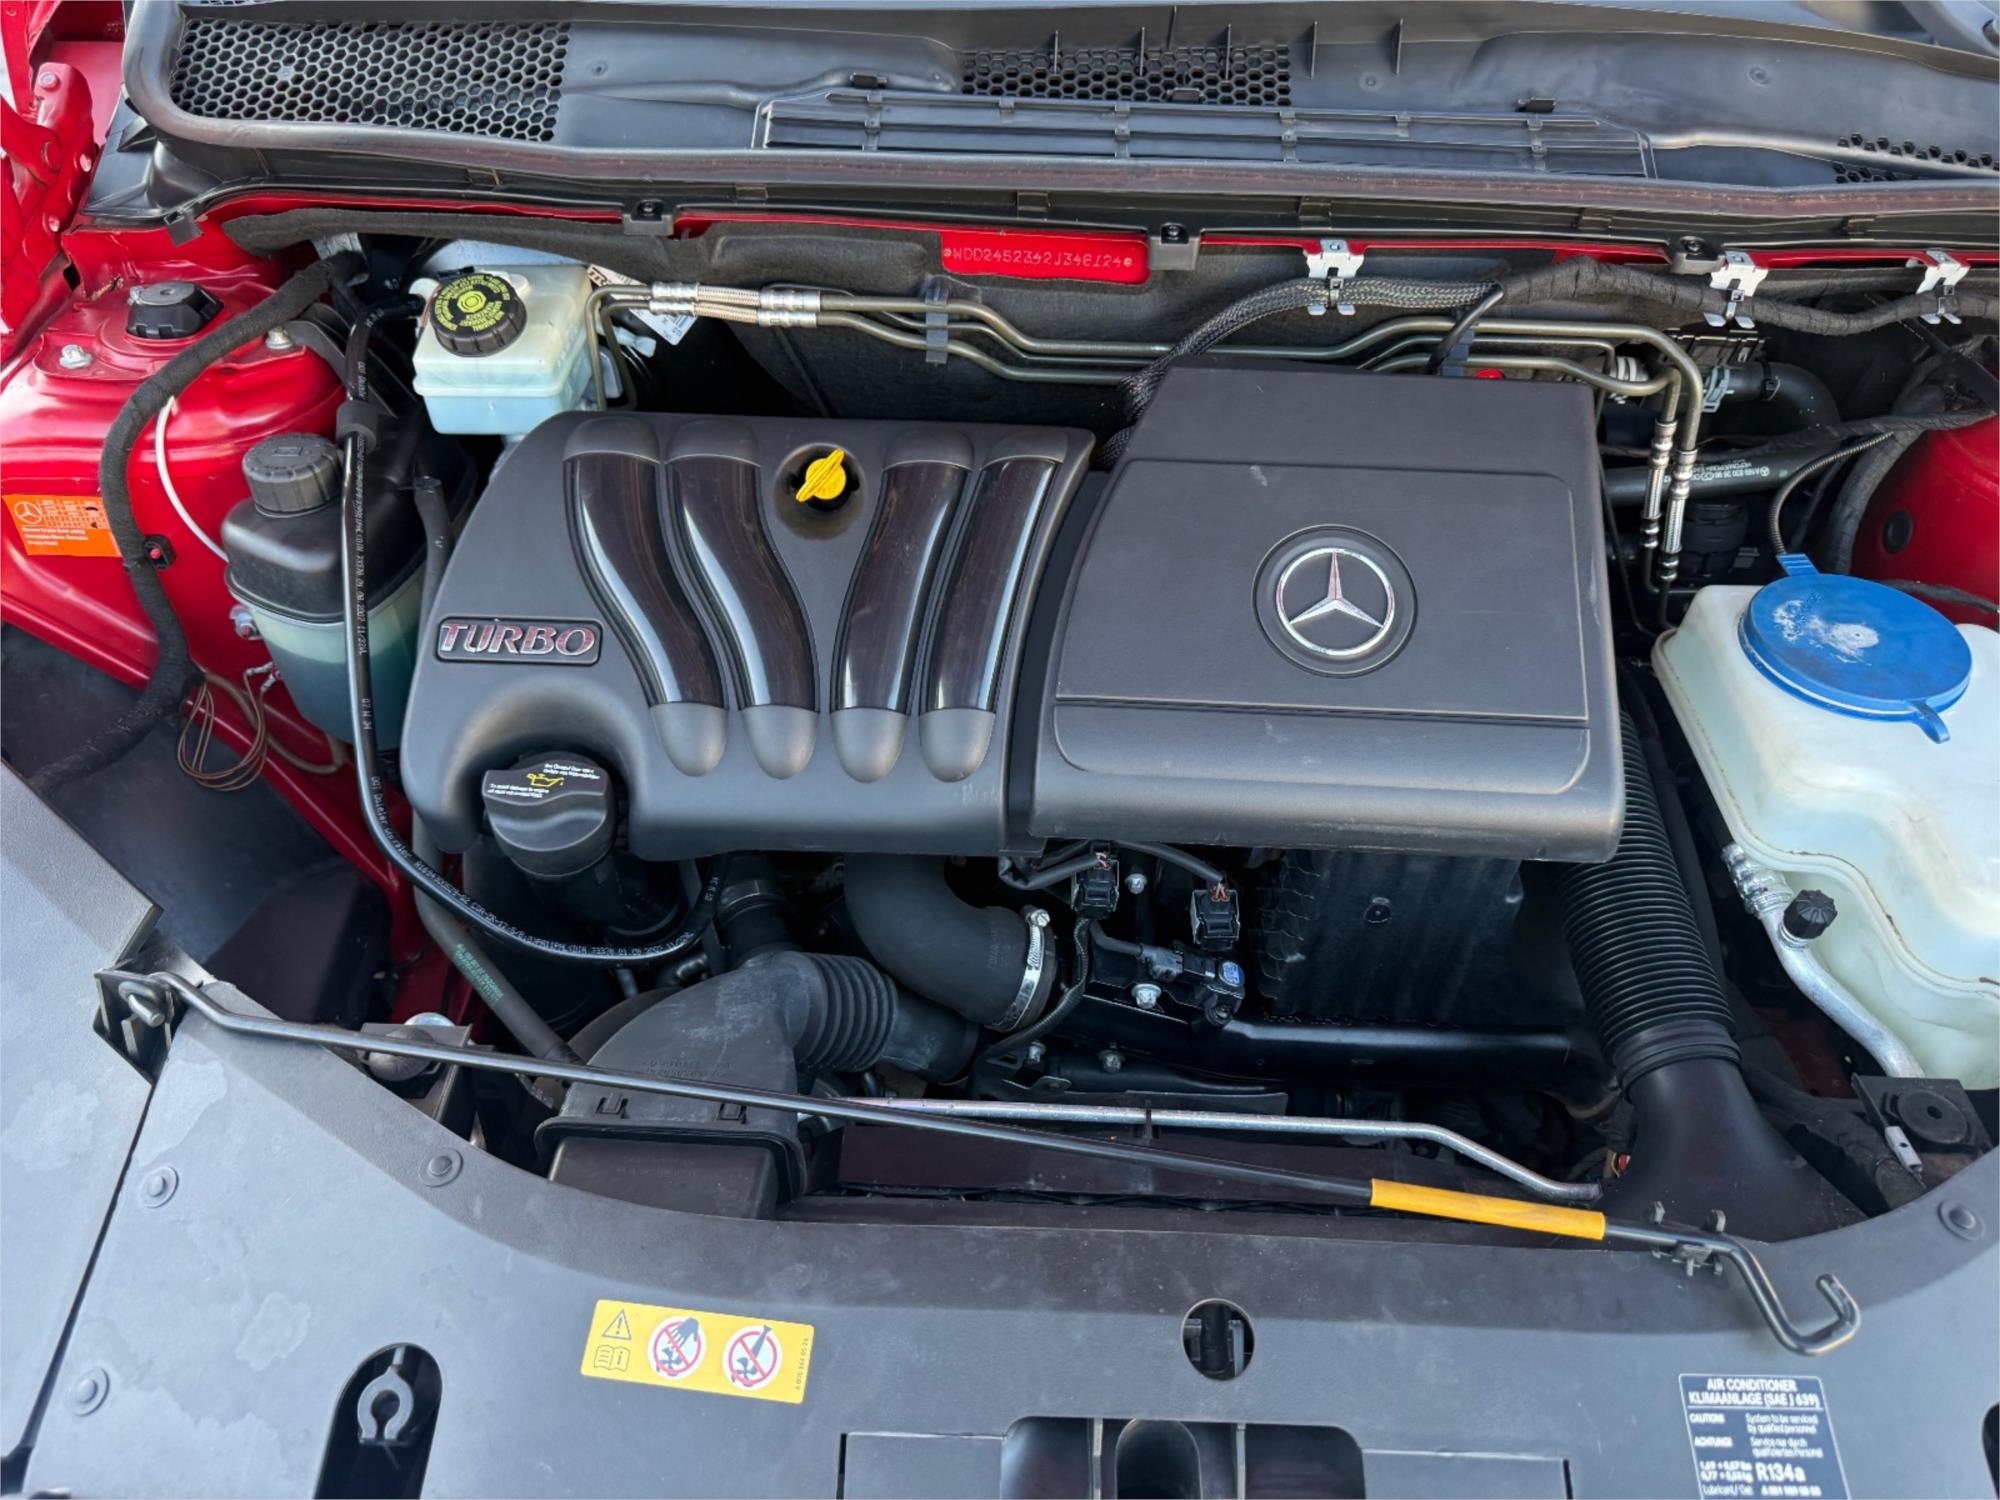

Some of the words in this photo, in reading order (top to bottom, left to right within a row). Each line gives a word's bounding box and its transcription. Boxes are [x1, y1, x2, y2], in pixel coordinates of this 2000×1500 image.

[440, 623, 596, 656] TURBO
[1707, 1378, 1726, 1391] AIR
[1726, 1378, 1798, 1392] CONDITIONER
[1688, 1391, 1763, 1406] KLIMAANLAGE
[1755, 1462, 1806, 1483] R134a
